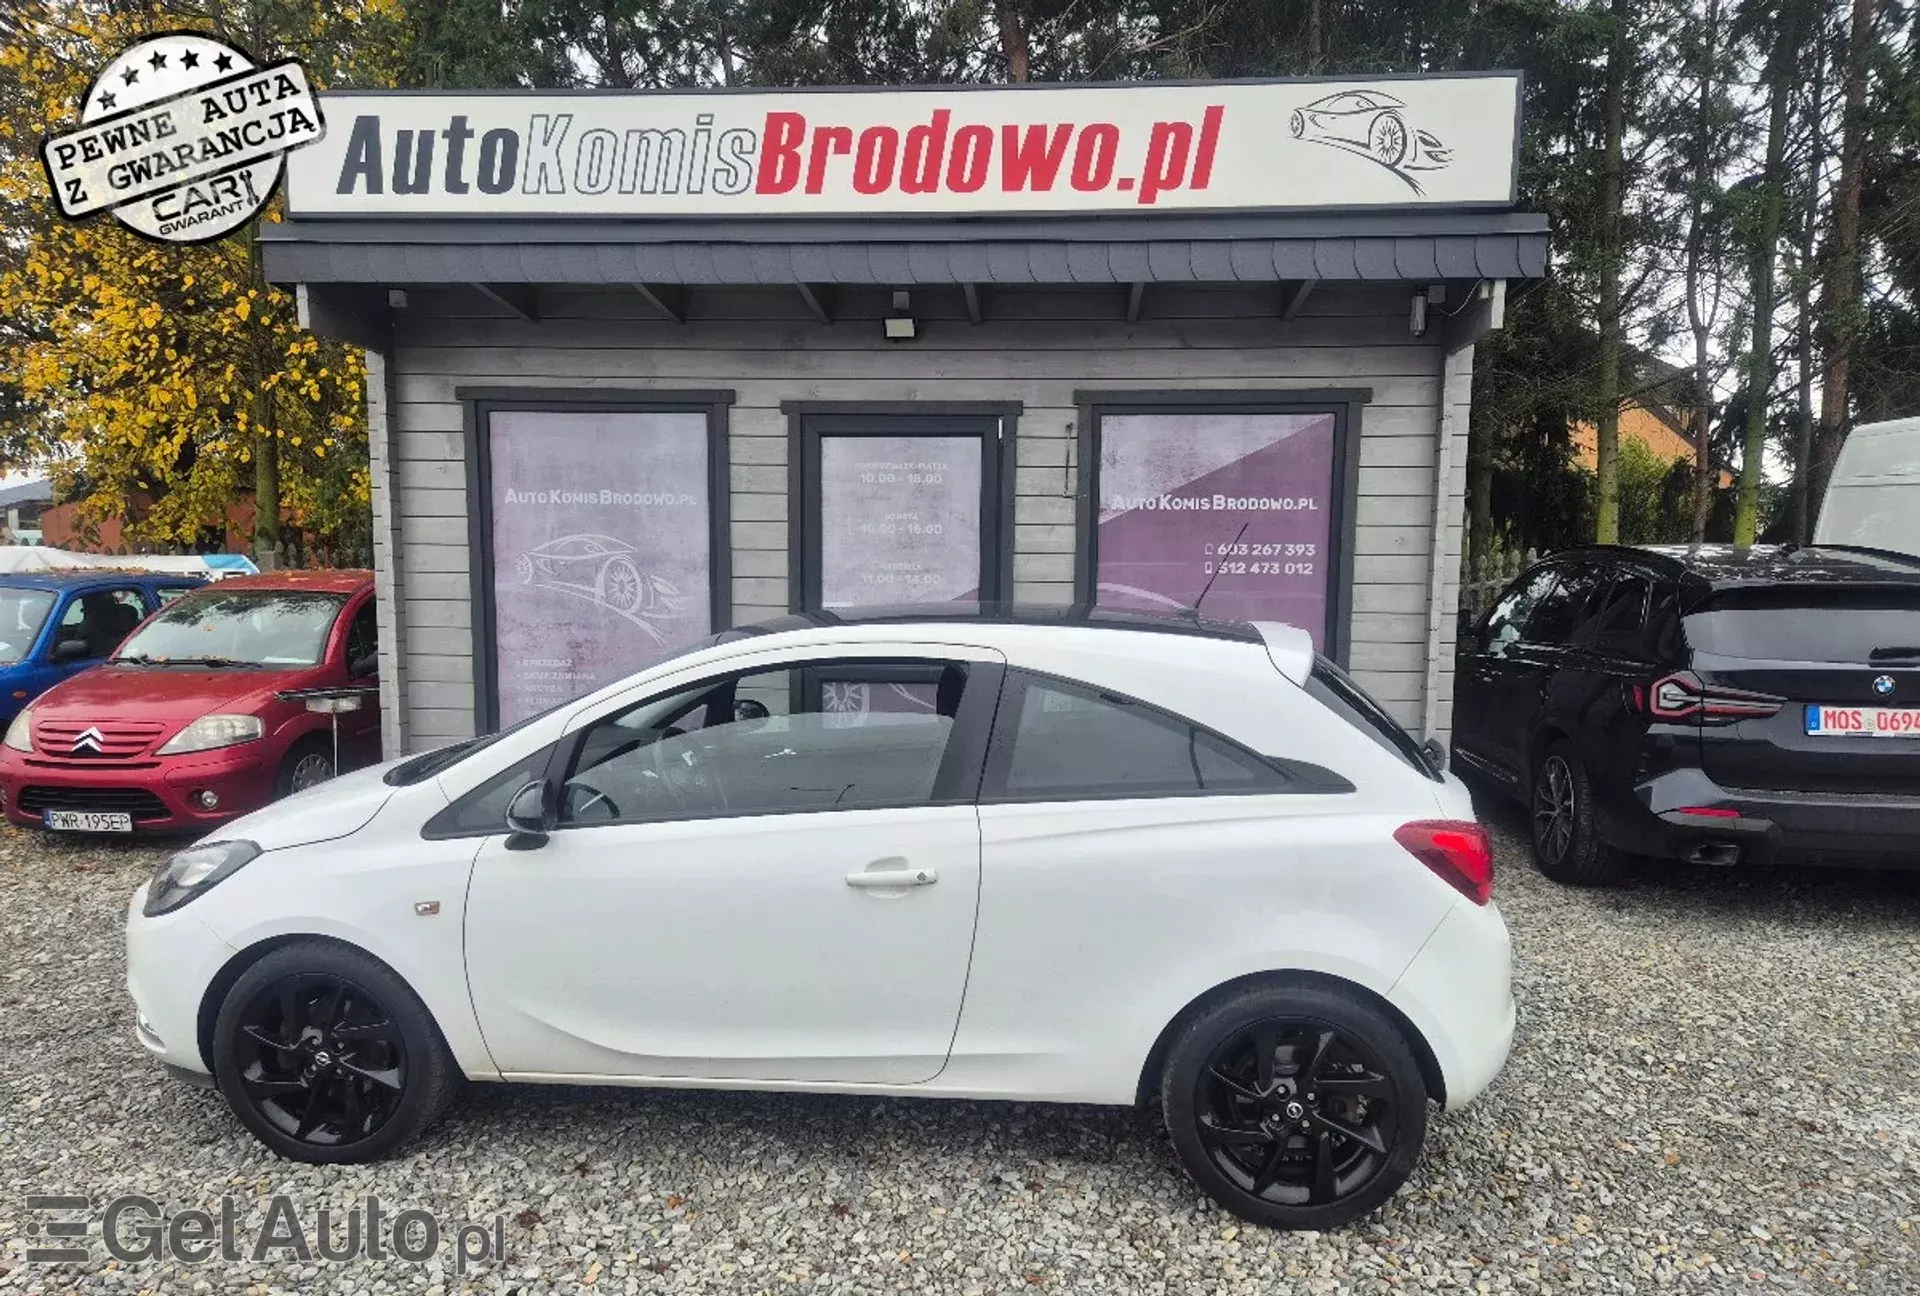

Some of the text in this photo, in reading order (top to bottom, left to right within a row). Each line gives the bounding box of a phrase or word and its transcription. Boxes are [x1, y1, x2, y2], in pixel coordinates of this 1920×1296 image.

[1217, 544, 1316, 556] 603 267 393
[1218, 562, 1313, 574] 512 473 012
[1824, 710, 1862, 730] MOS
[51, 813, 129, 830] PWR 195EP
